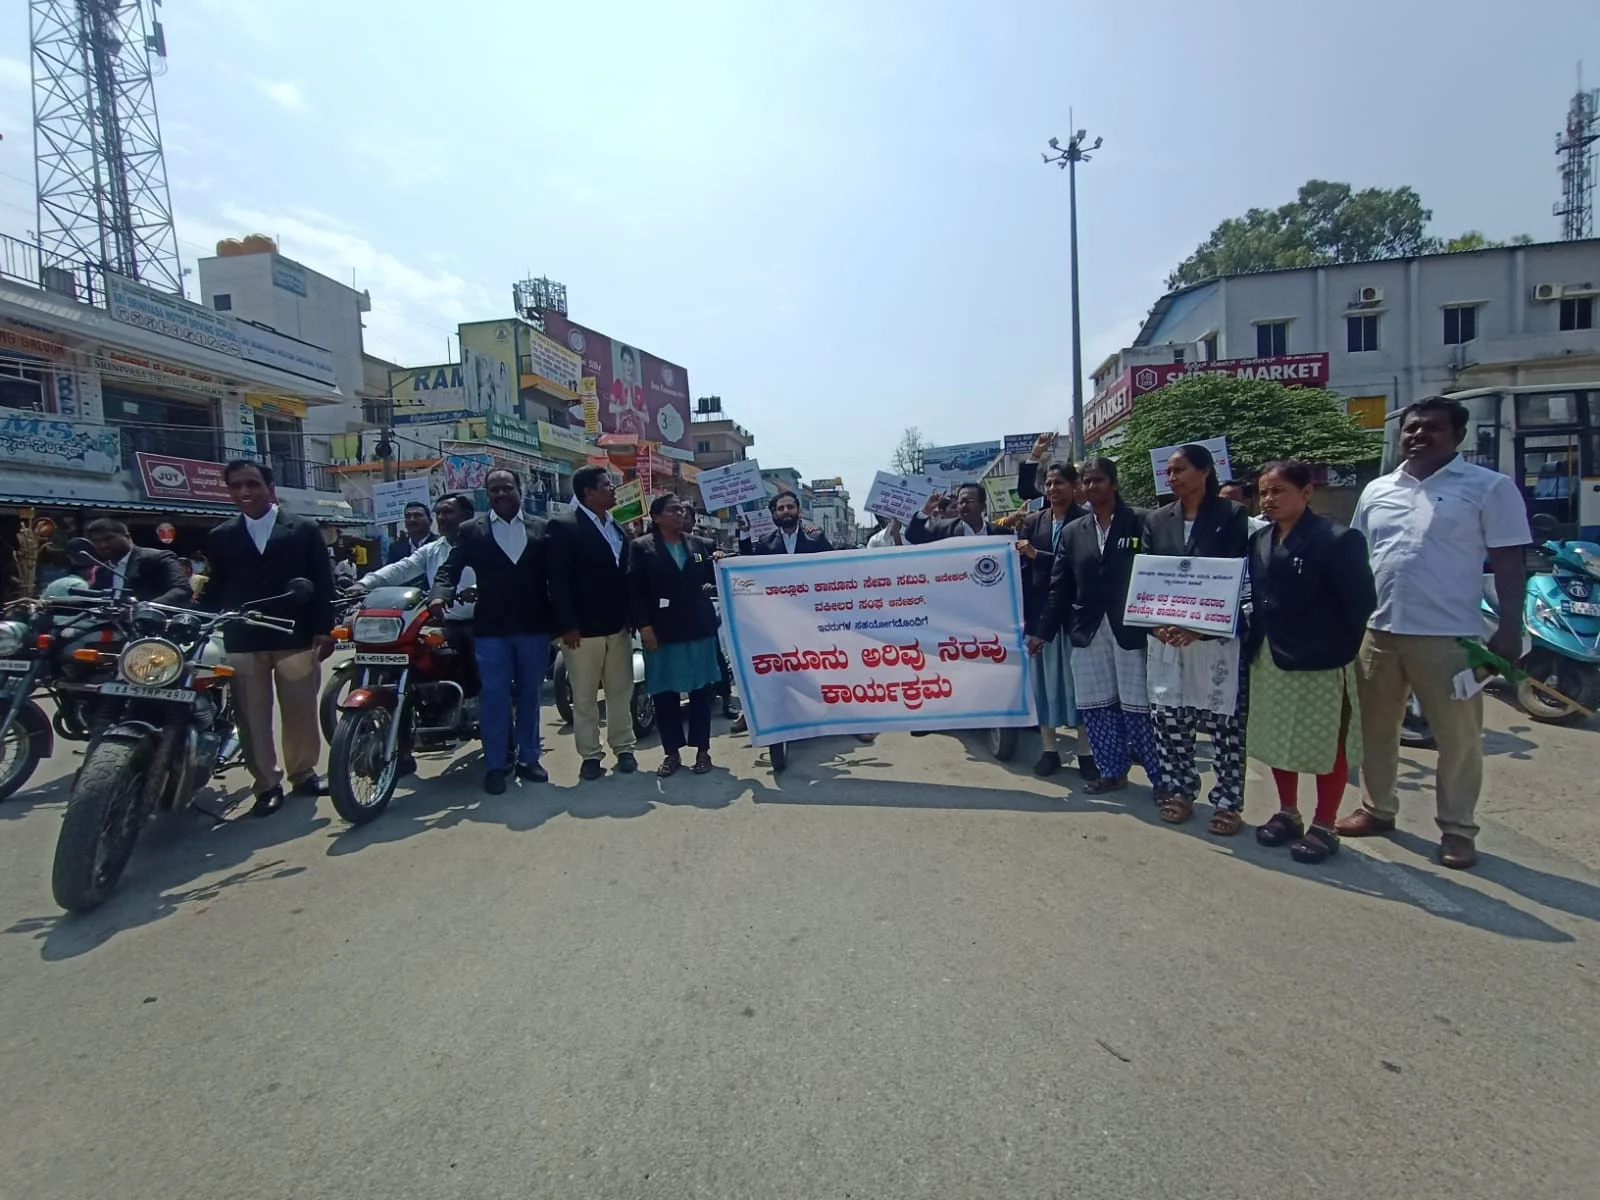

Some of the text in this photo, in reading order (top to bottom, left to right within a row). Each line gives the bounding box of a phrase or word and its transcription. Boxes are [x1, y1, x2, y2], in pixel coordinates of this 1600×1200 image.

[215, 324, 238, 343] SCHOOL
[1237, 362, 1322, 380] MARKET
[1096, 386, 1128, 428] MARKET
[765, 583, 809, 598] ತಾಲ್ಲೂಕು
[814, 579, 858, 593] ಕಾನೂನು
[863, 576, 892, 590] ಸೇವಾ
[814, 599, 854, 613] ವಕೀಲರ
[858, 598, 884, 611] ಸಂಘ
[817, 615, 929, 633] ಇವರುಗಳ ಸಹಯೋಗದೊಂದಿಗೆ
[752, 632, 1008, 675] ಕಾನೂನು ಅರಿವು ನೆರವು
[821, 671, 953, 710] ಕಾರ್ಯಕ್ರಮ
